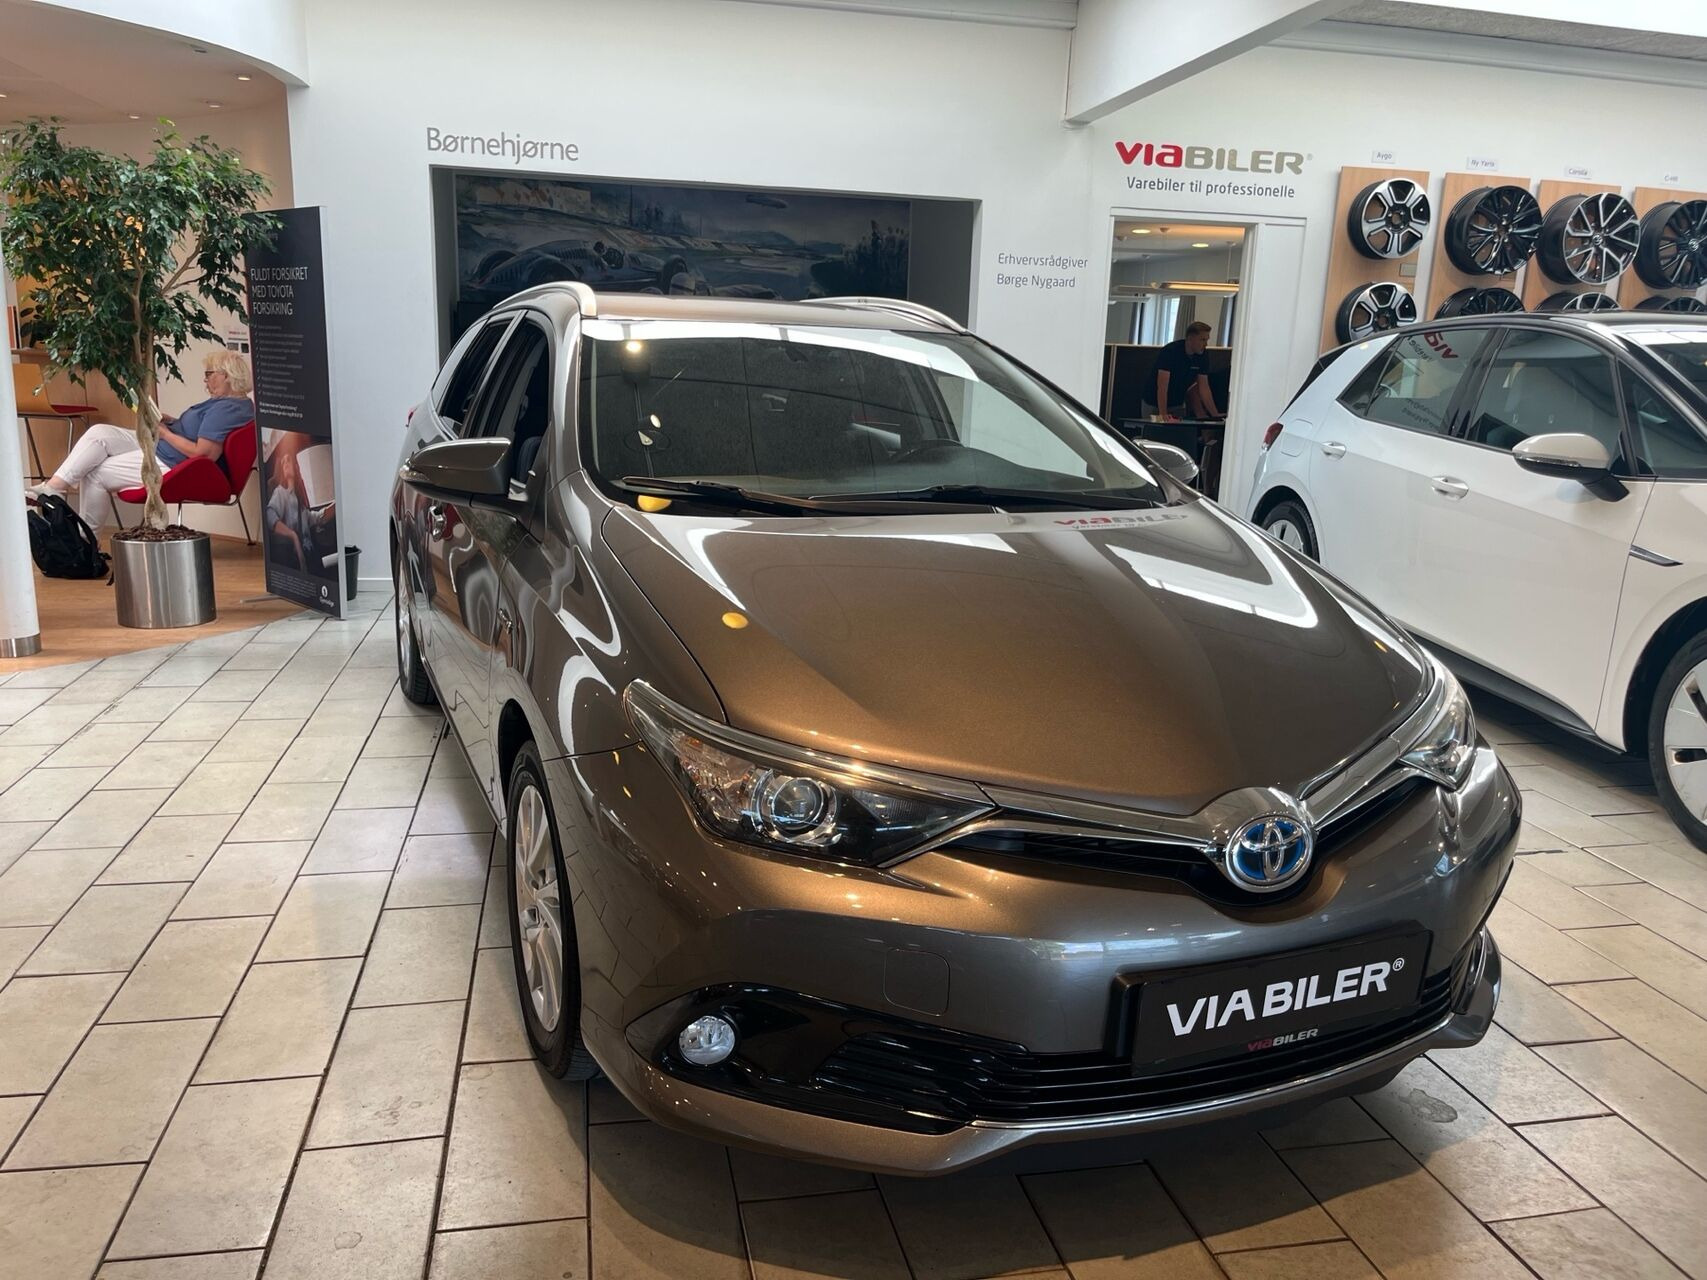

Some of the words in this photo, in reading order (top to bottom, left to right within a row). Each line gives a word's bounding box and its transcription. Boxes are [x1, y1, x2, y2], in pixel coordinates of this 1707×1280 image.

[427, 127, 579, 164] Børnehjørne
[1127, 176, 1186, 193] Varebiler
[1190, 180, 1202, 193] til
[1205, 182, 1295, 198] professionelle
[998, 252, 1089, 270] Erhvervsrådgiver
[250, 267, 271, 281] FULDT
[272, 266, 308, 281] FORSIKRET
[996, 273, 1029, 288] Børge
[1031, 274, 1076, 290] Nygaard
[252, 284, 267, 298] MED
[267, 284, 294, 298] TOYOTA
[252, 301, 293, 316] FORSIKRING
[1167, 988, 1256, 1037] VIA
